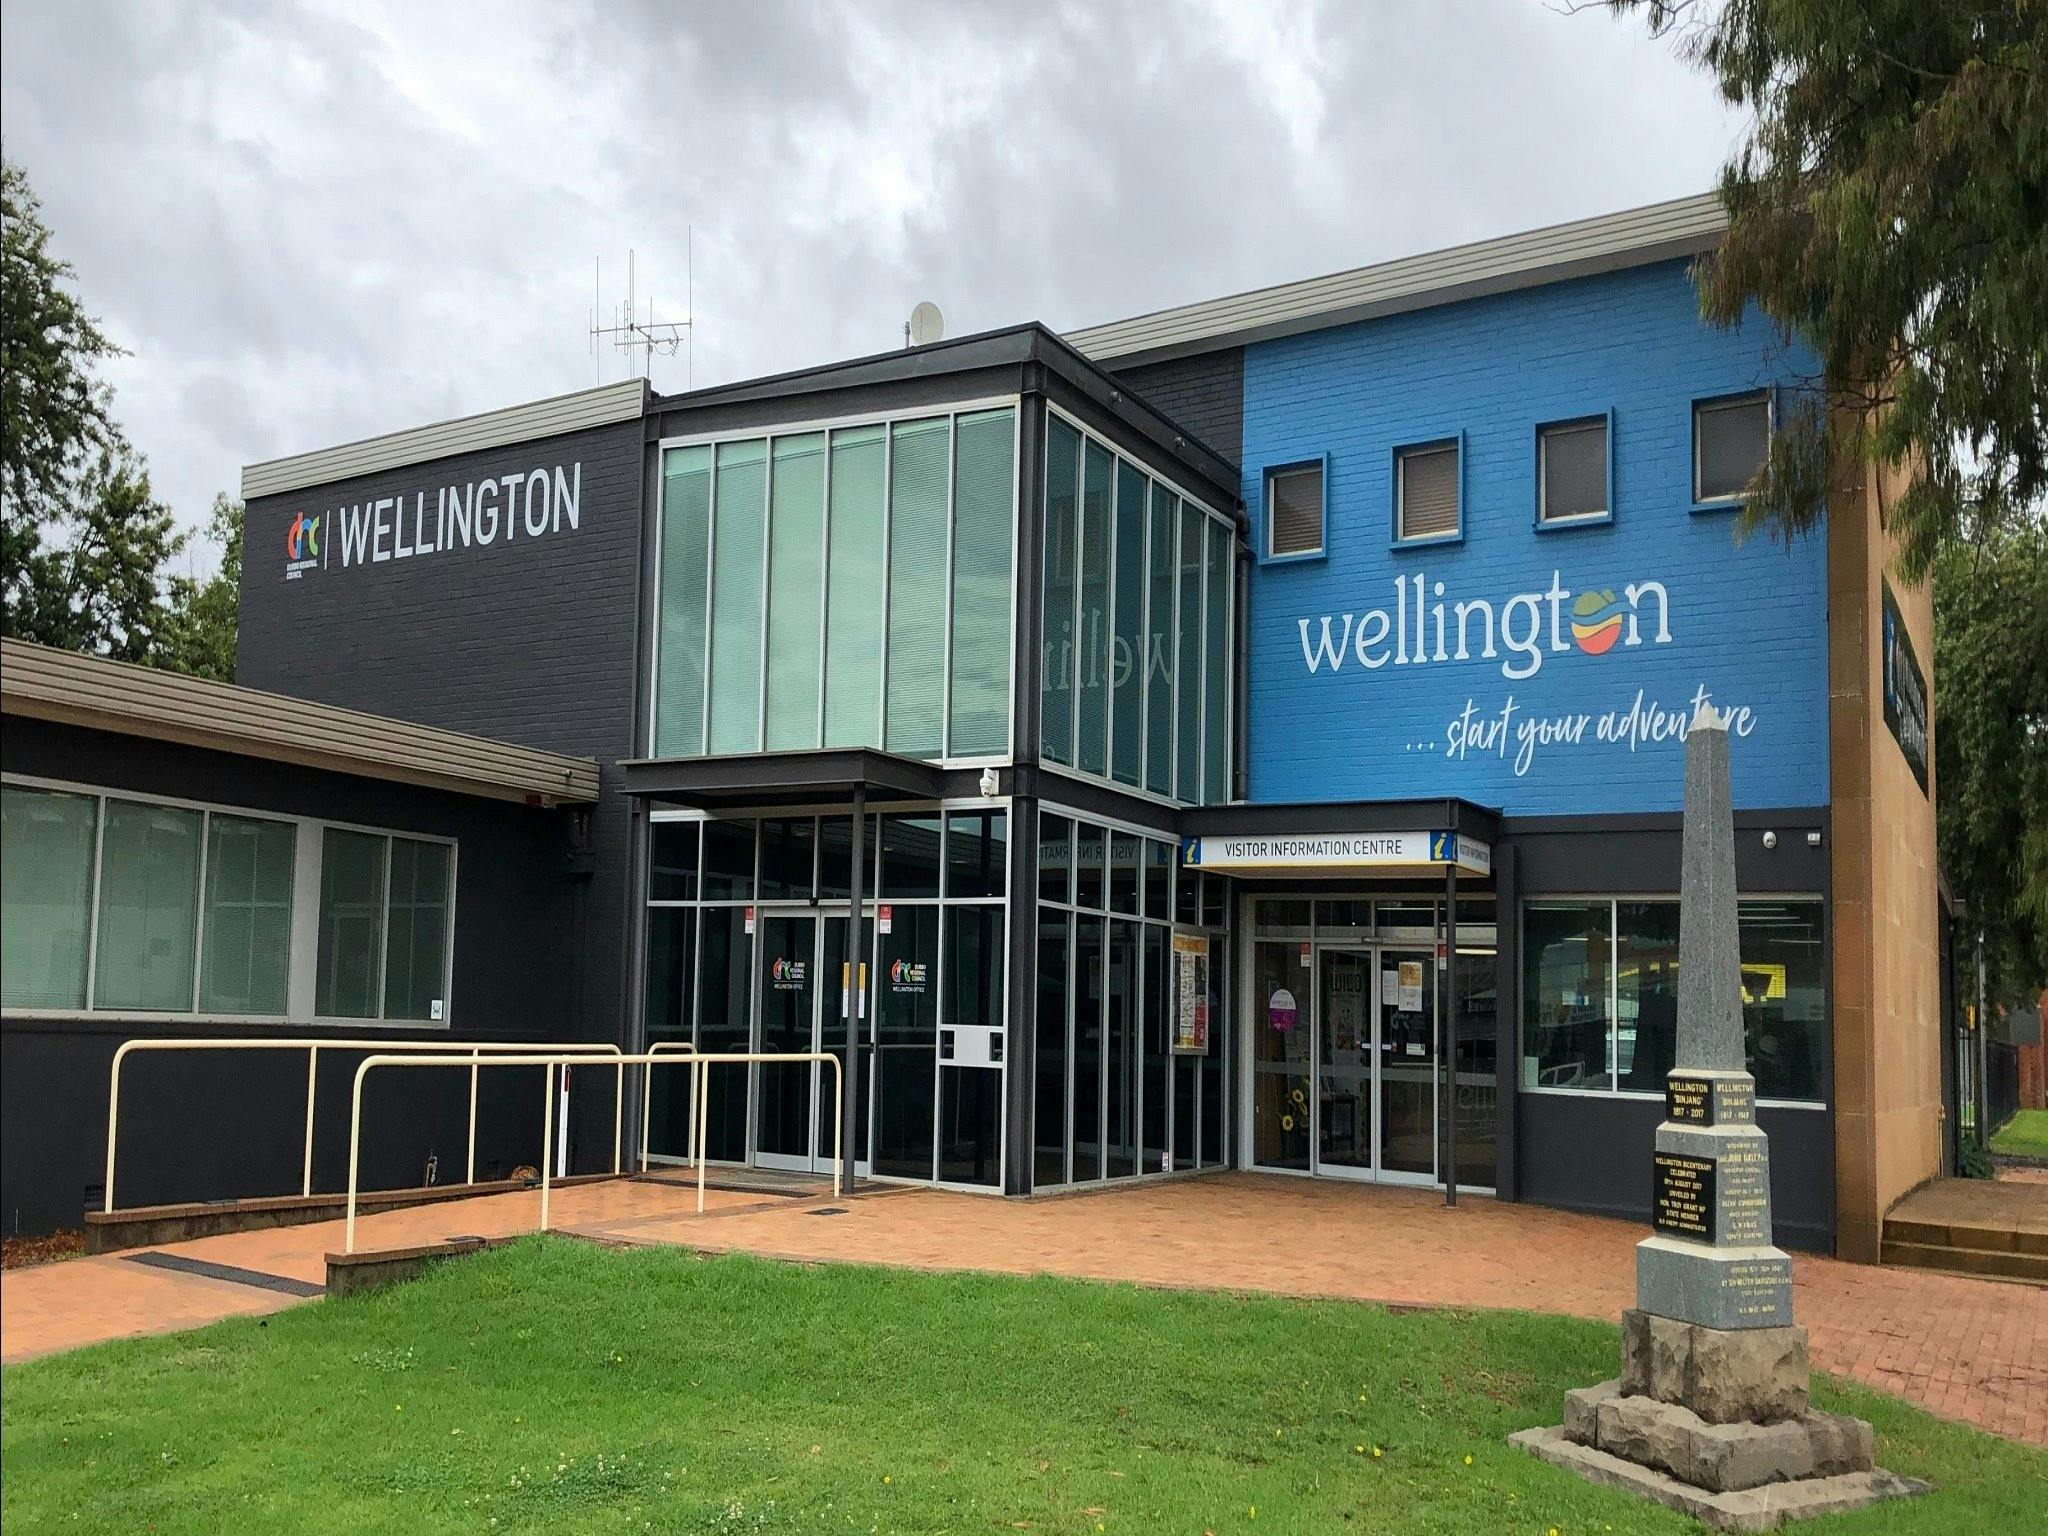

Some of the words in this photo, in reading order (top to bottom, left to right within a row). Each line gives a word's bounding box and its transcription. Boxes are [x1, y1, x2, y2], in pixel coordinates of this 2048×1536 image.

[340, 462, 581, 567] WELLINGTON
[1298, 569, 1673, 680] wellington
[1446, 696, 1520, 760] start
[1517, 711, 1596, 776] your
[1225, 842, 1268, 857] VISITOR
[1270, 841, 1351, 857] INFORMATION
[1353, 839, 1403, 856] CENTRE
[1669, 1082, 1708, 1093] WELLINGTON
[1690, 1109, 1704, 1118] 2017
